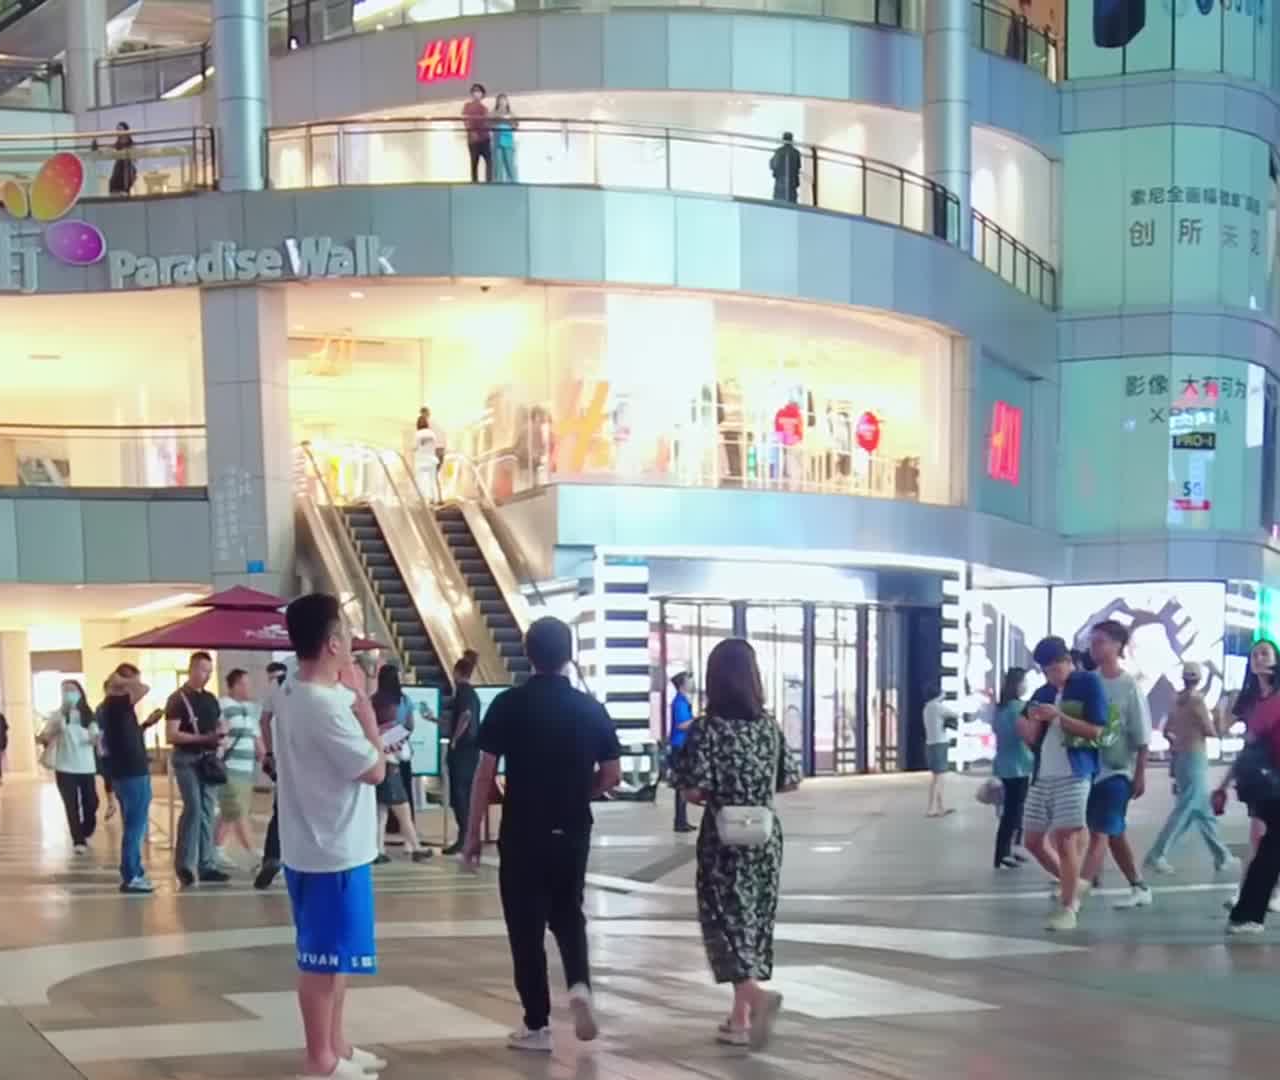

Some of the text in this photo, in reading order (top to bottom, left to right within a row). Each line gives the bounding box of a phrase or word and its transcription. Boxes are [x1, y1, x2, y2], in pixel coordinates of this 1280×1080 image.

[417, 36, 473, 81] H&M
[110, 233, 398, 289] Paradise Walk
